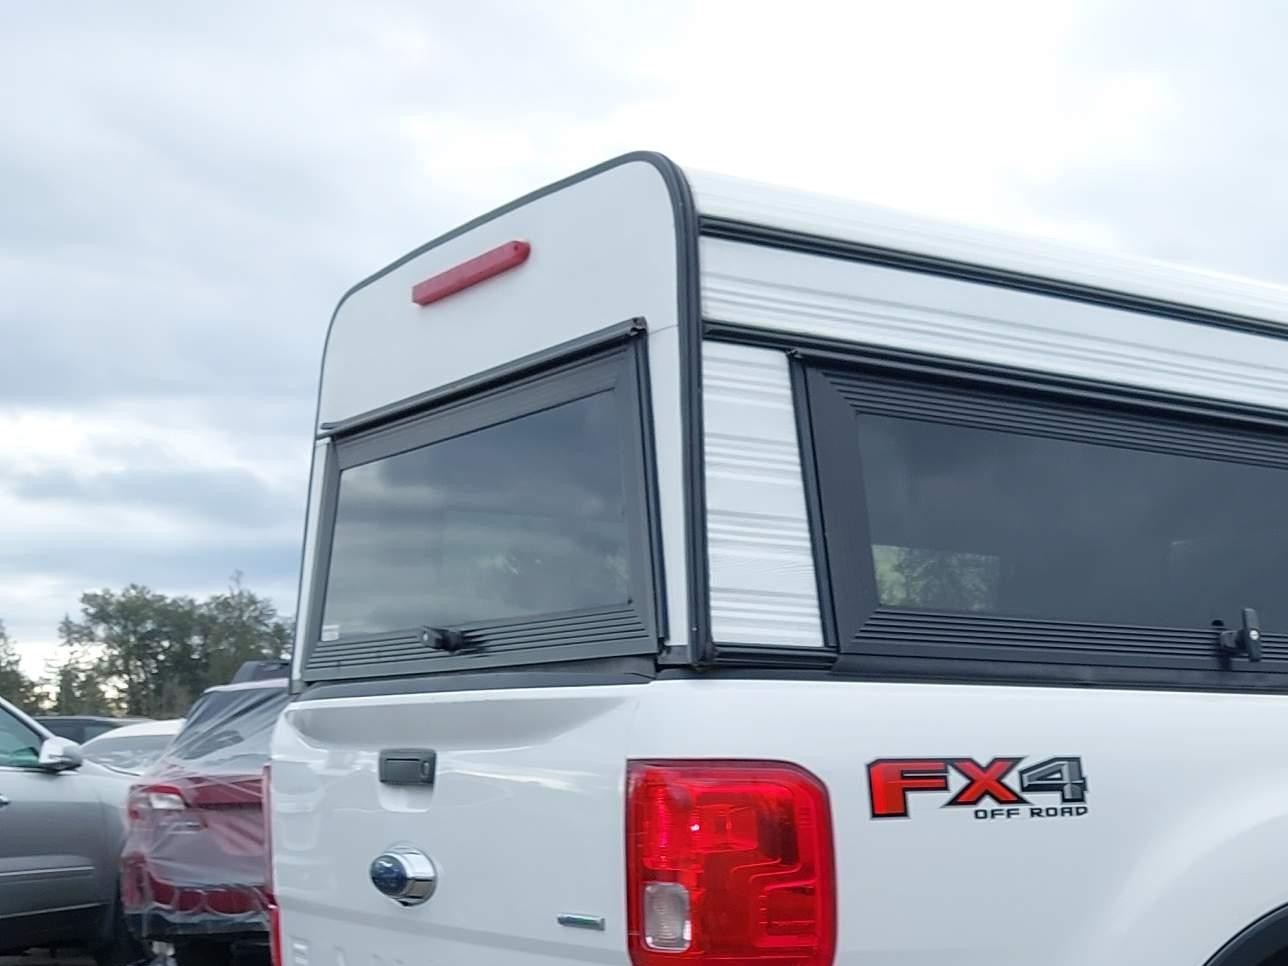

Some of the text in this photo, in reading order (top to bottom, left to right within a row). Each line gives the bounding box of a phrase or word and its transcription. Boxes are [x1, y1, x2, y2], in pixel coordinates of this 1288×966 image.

[866, 756, 1088, 818] FX4
[973, 806, 1088, 819] OFF ROAD
